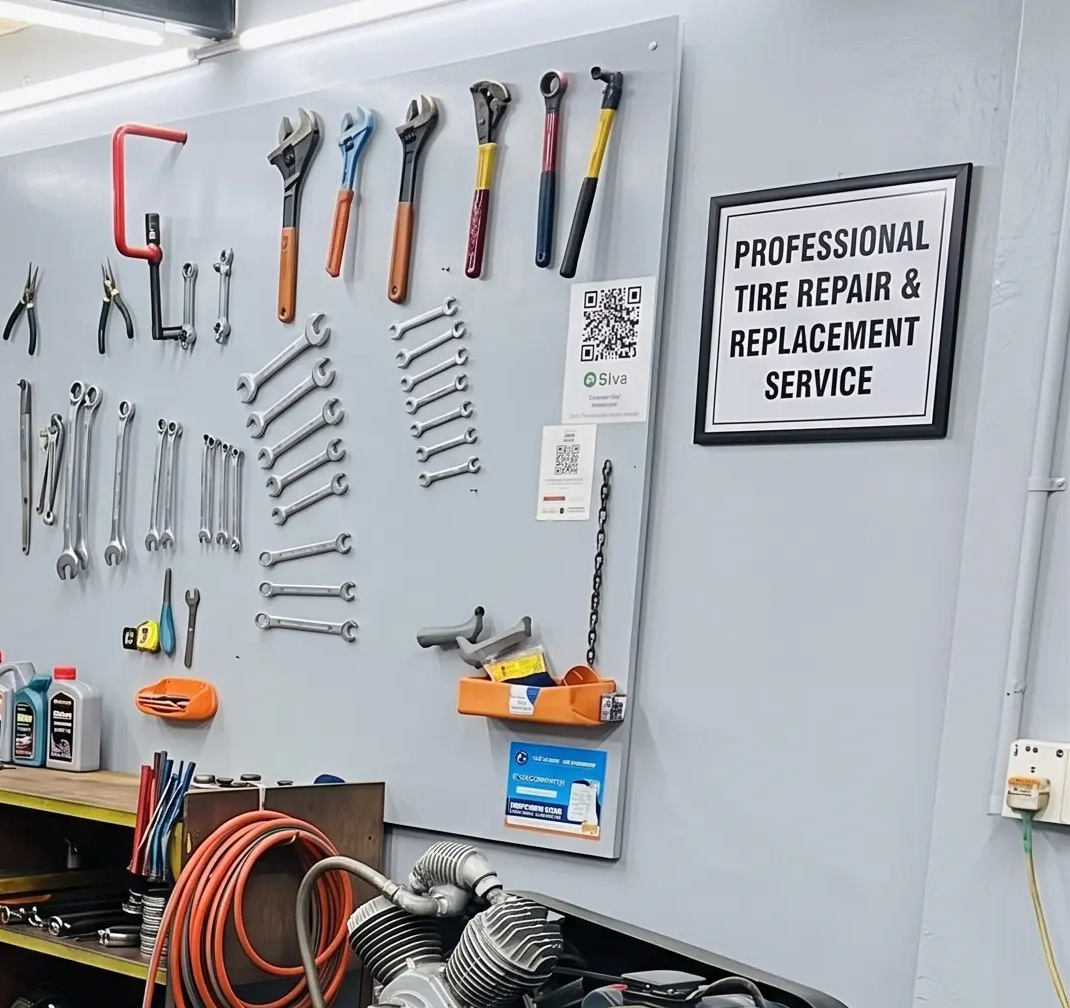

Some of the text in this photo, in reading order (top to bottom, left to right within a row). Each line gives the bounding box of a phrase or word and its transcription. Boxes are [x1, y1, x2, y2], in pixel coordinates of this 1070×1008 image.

[734, 220, 930, 269] PROFESSIONAL
[735, 268, 921, 313] TIRE REPAIR &
[730, 316, 920, 358] REPLACEMENT
[764, 366, 873, 400] SERVICE
